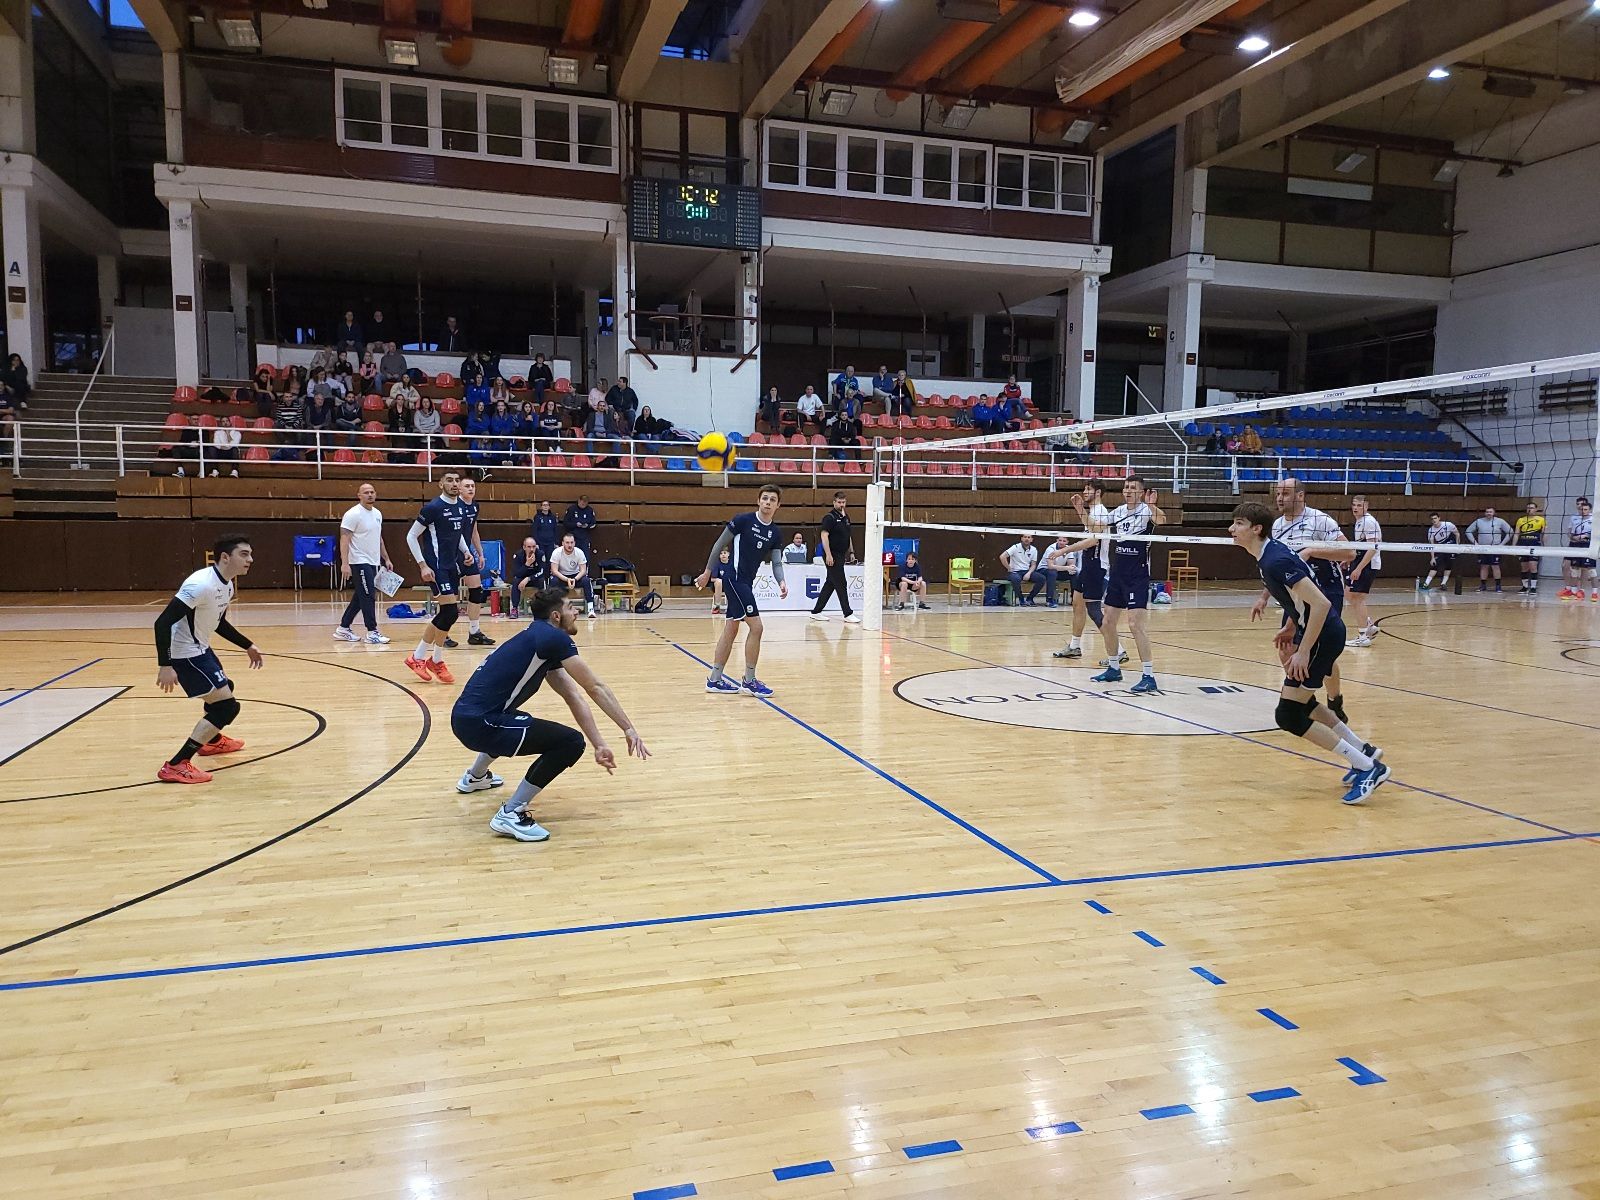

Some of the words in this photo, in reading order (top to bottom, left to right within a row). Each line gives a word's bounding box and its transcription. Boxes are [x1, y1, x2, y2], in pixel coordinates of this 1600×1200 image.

[9, 261, 21, 275] A
[1169, 330, 1175, 341] C
[453, 521, 462, 530] 15
[756, 541, 763, 549] 9
[440, 582, 451, 592] 15
[746, 604, 754, 613] 9
